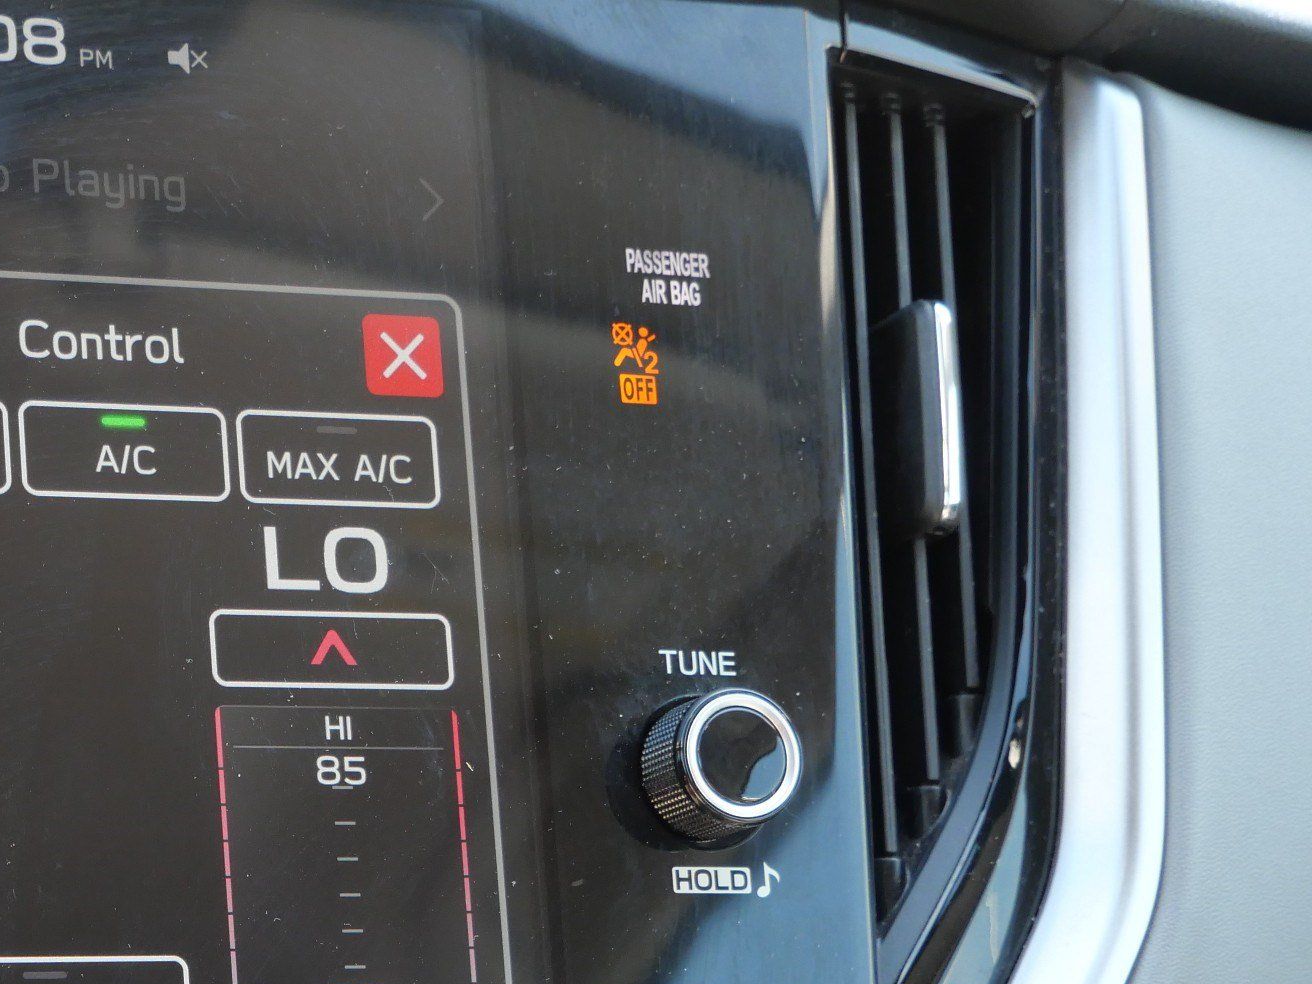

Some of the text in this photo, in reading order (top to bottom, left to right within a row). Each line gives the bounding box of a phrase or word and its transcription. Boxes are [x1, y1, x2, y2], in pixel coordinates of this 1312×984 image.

[80, 49, 113, 70] PM
[33, 159, 186, 212] Playing
[626, 249, 709, 278] PASSENGER
[642, 279, 700, 306] AIR BAG
[19, 320, 184, 363] Control
[623, 376, 655, 401] OFF
[96, 445, 156, 474] A/C
[267, 451, 412, 483] MAX A/C
[264, 526, 389, 593] LO
[659, 650, 736, 676] TUNE
[325, 716, 352, 740] HI
[317, 756, 366, 785] 85
[674, 869, 749, 891] HOLD
